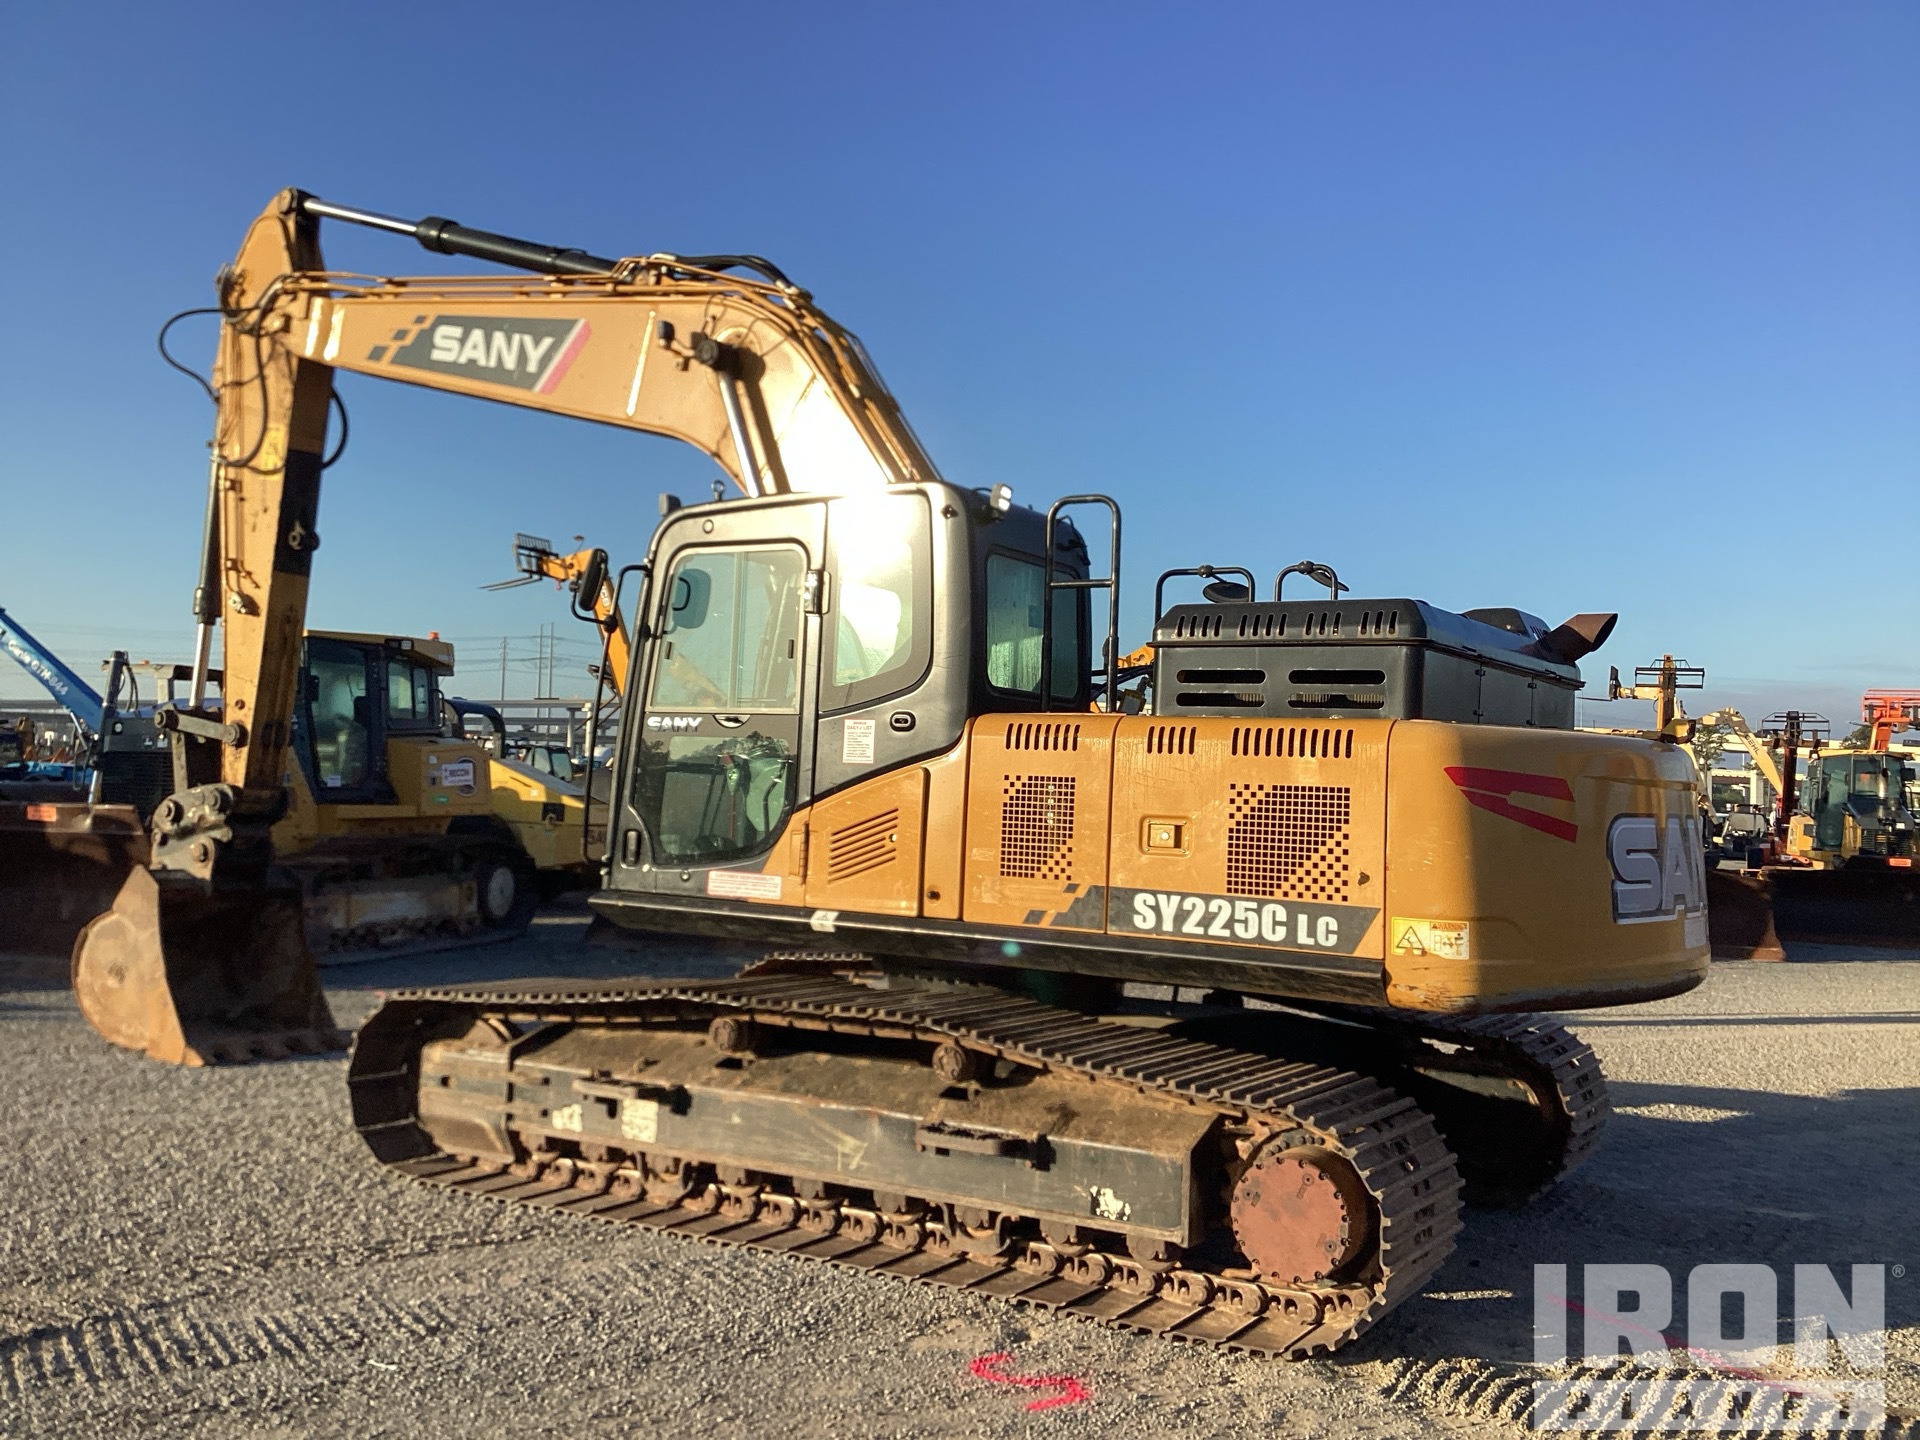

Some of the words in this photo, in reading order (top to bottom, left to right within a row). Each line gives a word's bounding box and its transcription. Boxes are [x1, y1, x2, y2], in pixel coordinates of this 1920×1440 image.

[430, 324, 555, 374] SANY
[647, 716, 703, 731] SANY
[1744, 734, 1760, 756] GEHL
[1132, 892, 1288, 943] SY225C
[1296, 913, 1339, 947] LC
